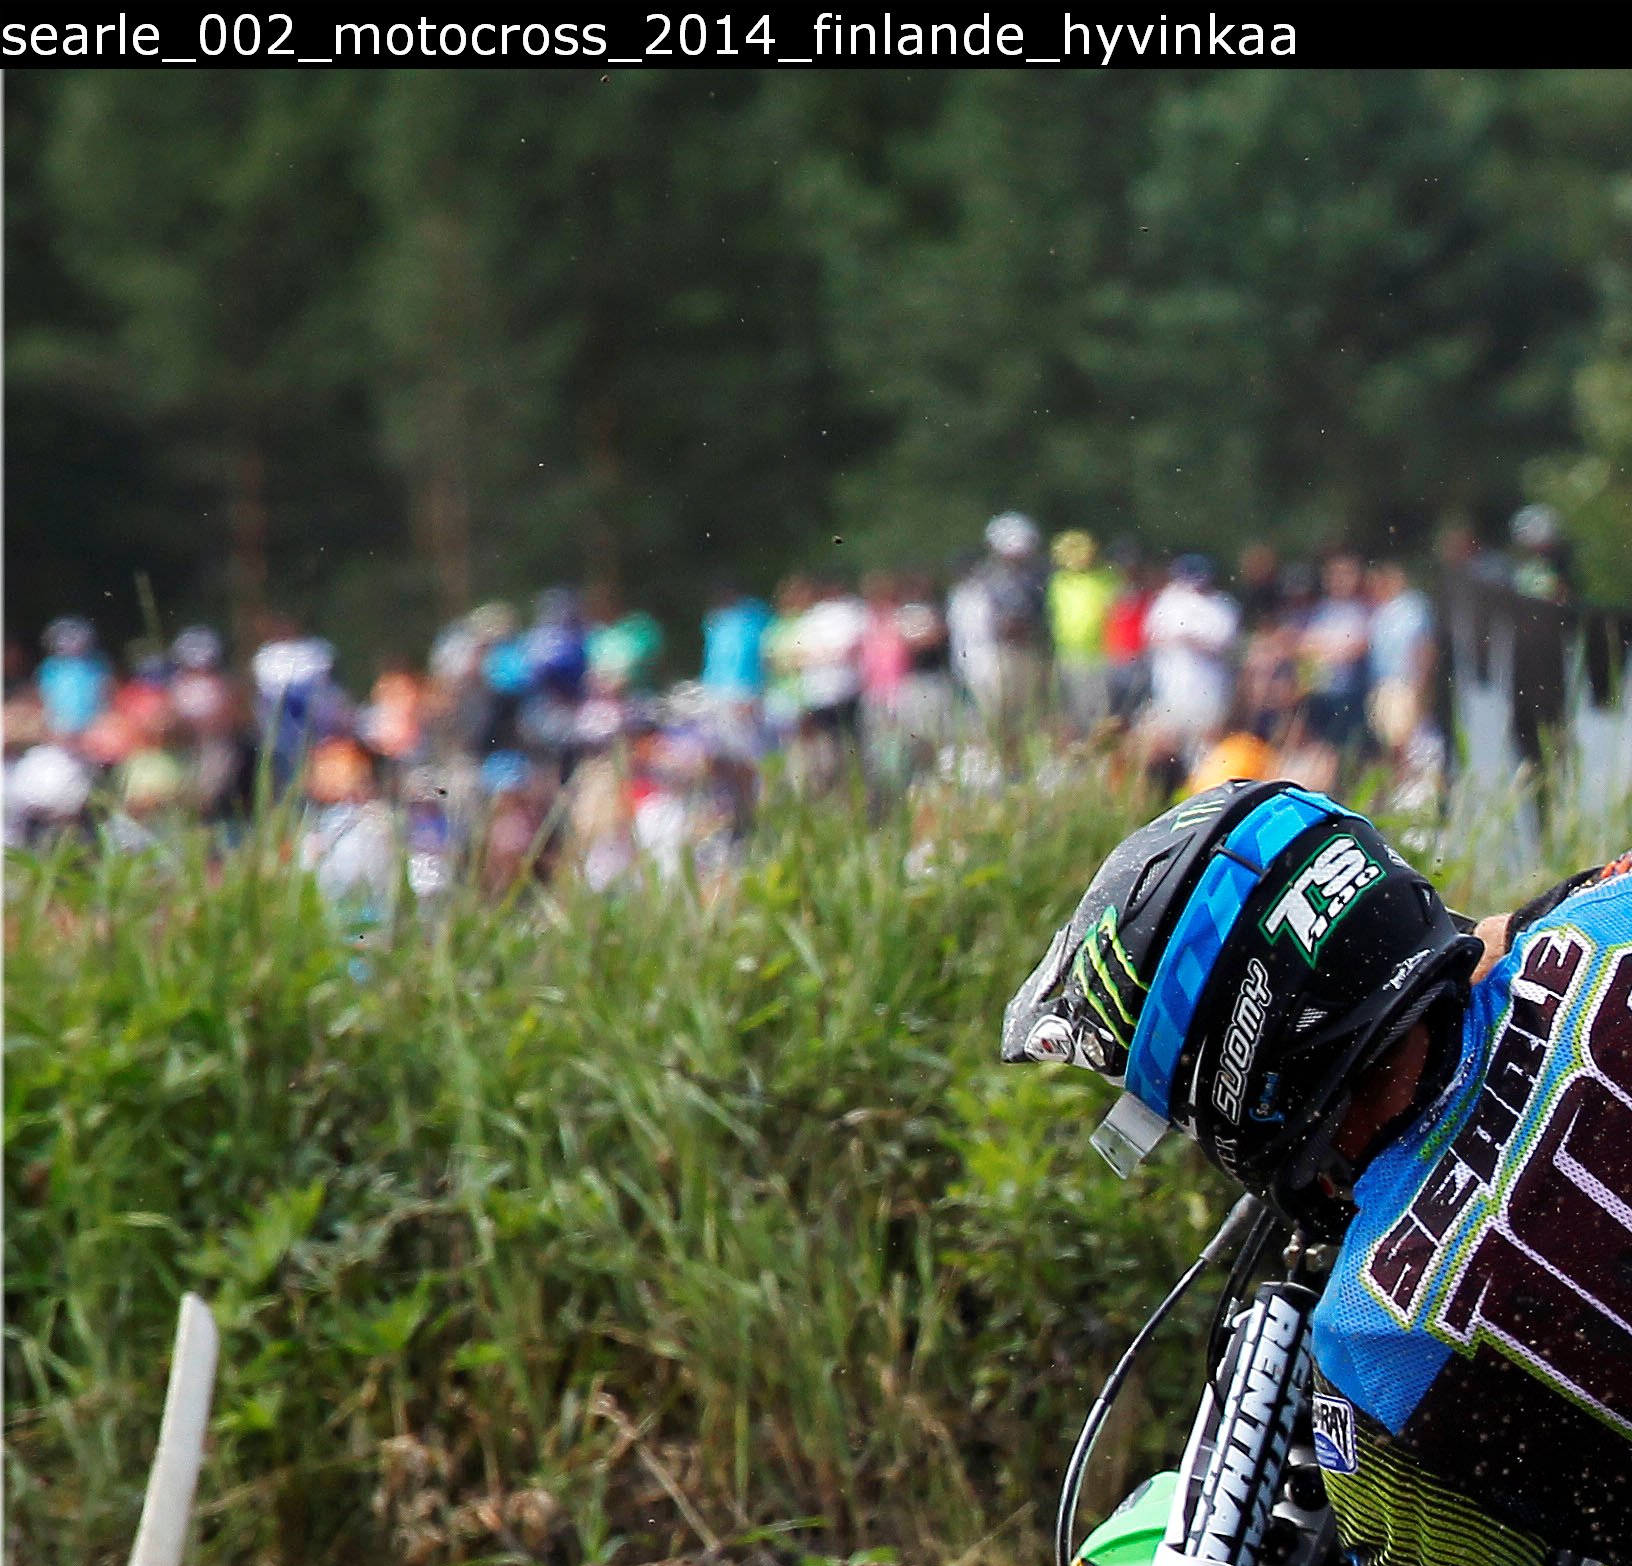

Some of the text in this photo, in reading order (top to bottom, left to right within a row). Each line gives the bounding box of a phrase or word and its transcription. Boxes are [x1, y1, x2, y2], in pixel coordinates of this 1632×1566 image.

[1211, 957, 1273, 1126] SUOMY
[1362, 928, 1594, 1326] SEARLE
[1197, 1293, 1301, 1563] RENTHAL
